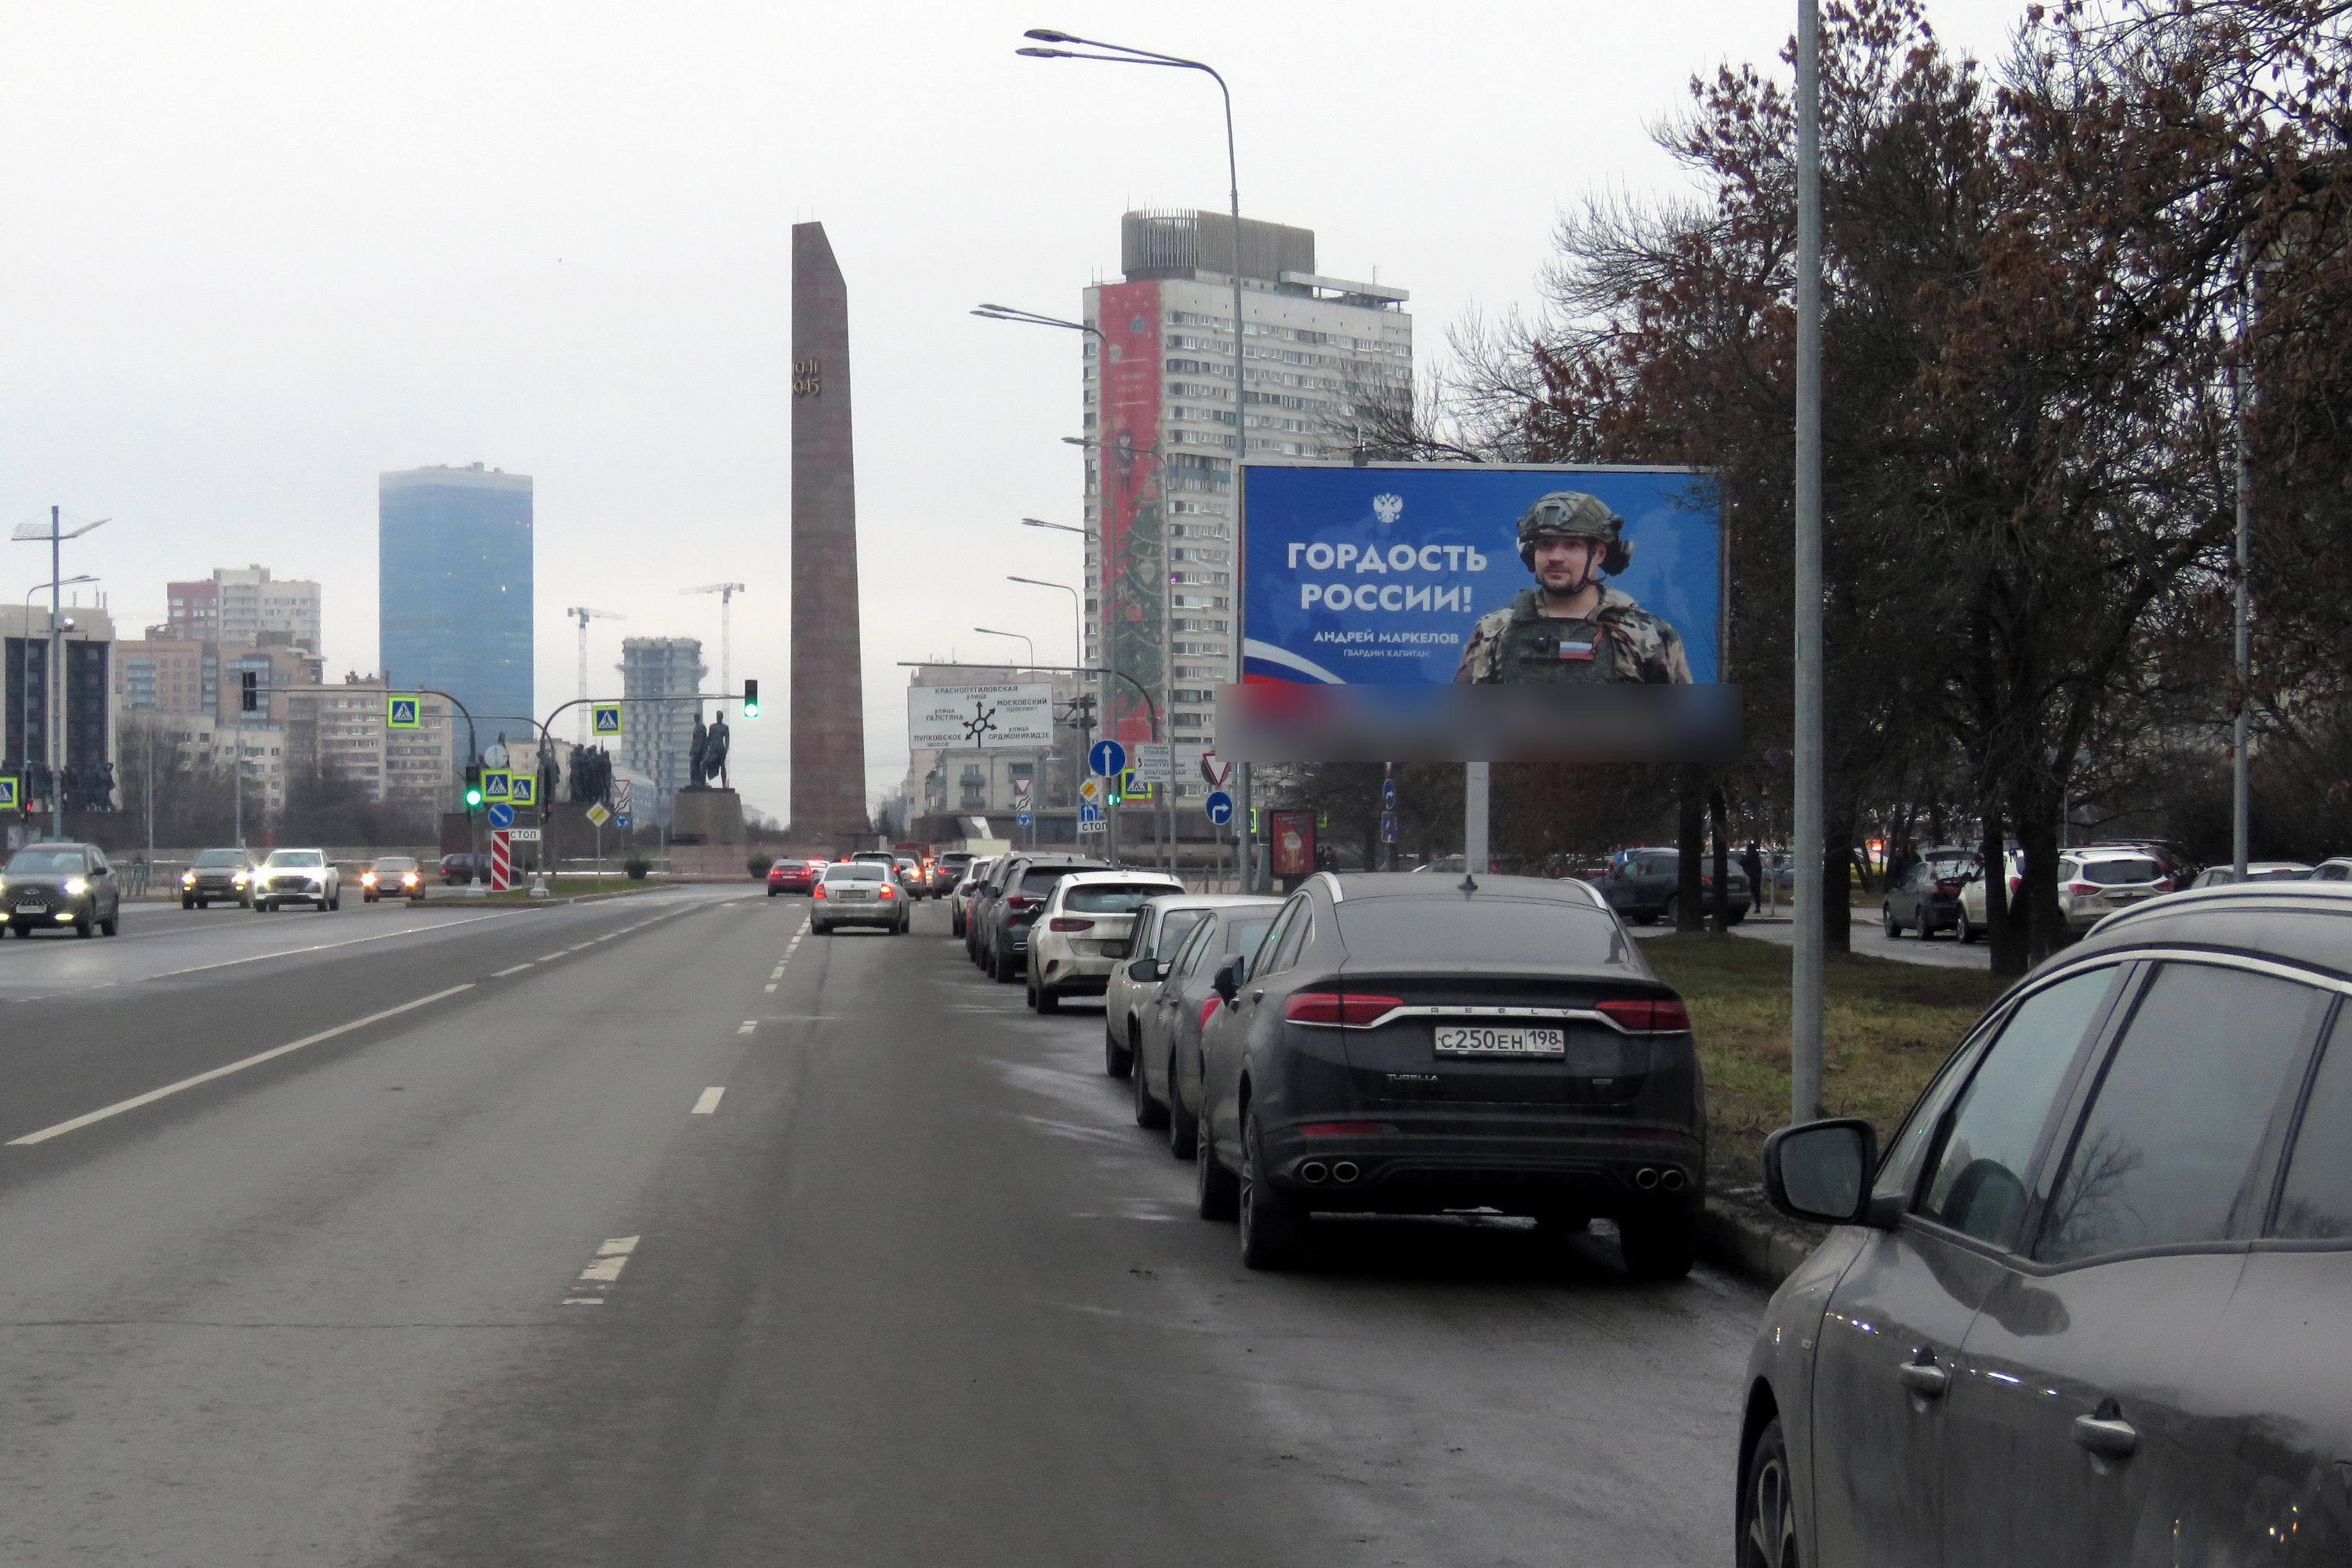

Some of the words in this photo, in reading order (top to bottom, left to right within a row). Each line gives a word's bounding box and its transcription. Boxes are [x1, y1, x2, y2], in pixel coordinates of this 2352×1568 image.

[1288, 543, 1487, 574] ГОРДОСТЬ
[1301, 583, 1472, 613] РОССИИ!
[1313, 630, 1374, 643] АНДРЕЙ
[1378, 632, 1459, 644] МАРКЕЛОВ
[1343, 649, 1385, 658] ГВАРДИИ
[1387, 649, 1429, 658] КАПИТАН
[935, 685, 1018, 695] КРАСНОПУТИЛОВСКАЯ
[996, 698, 1047, 706] МОСКОВСКИЙ
[1083, 822, 1108, 832] СТОП
[510, 830, 537, 839] СТОП
[1529, 1031, 1559, 1045] 198
